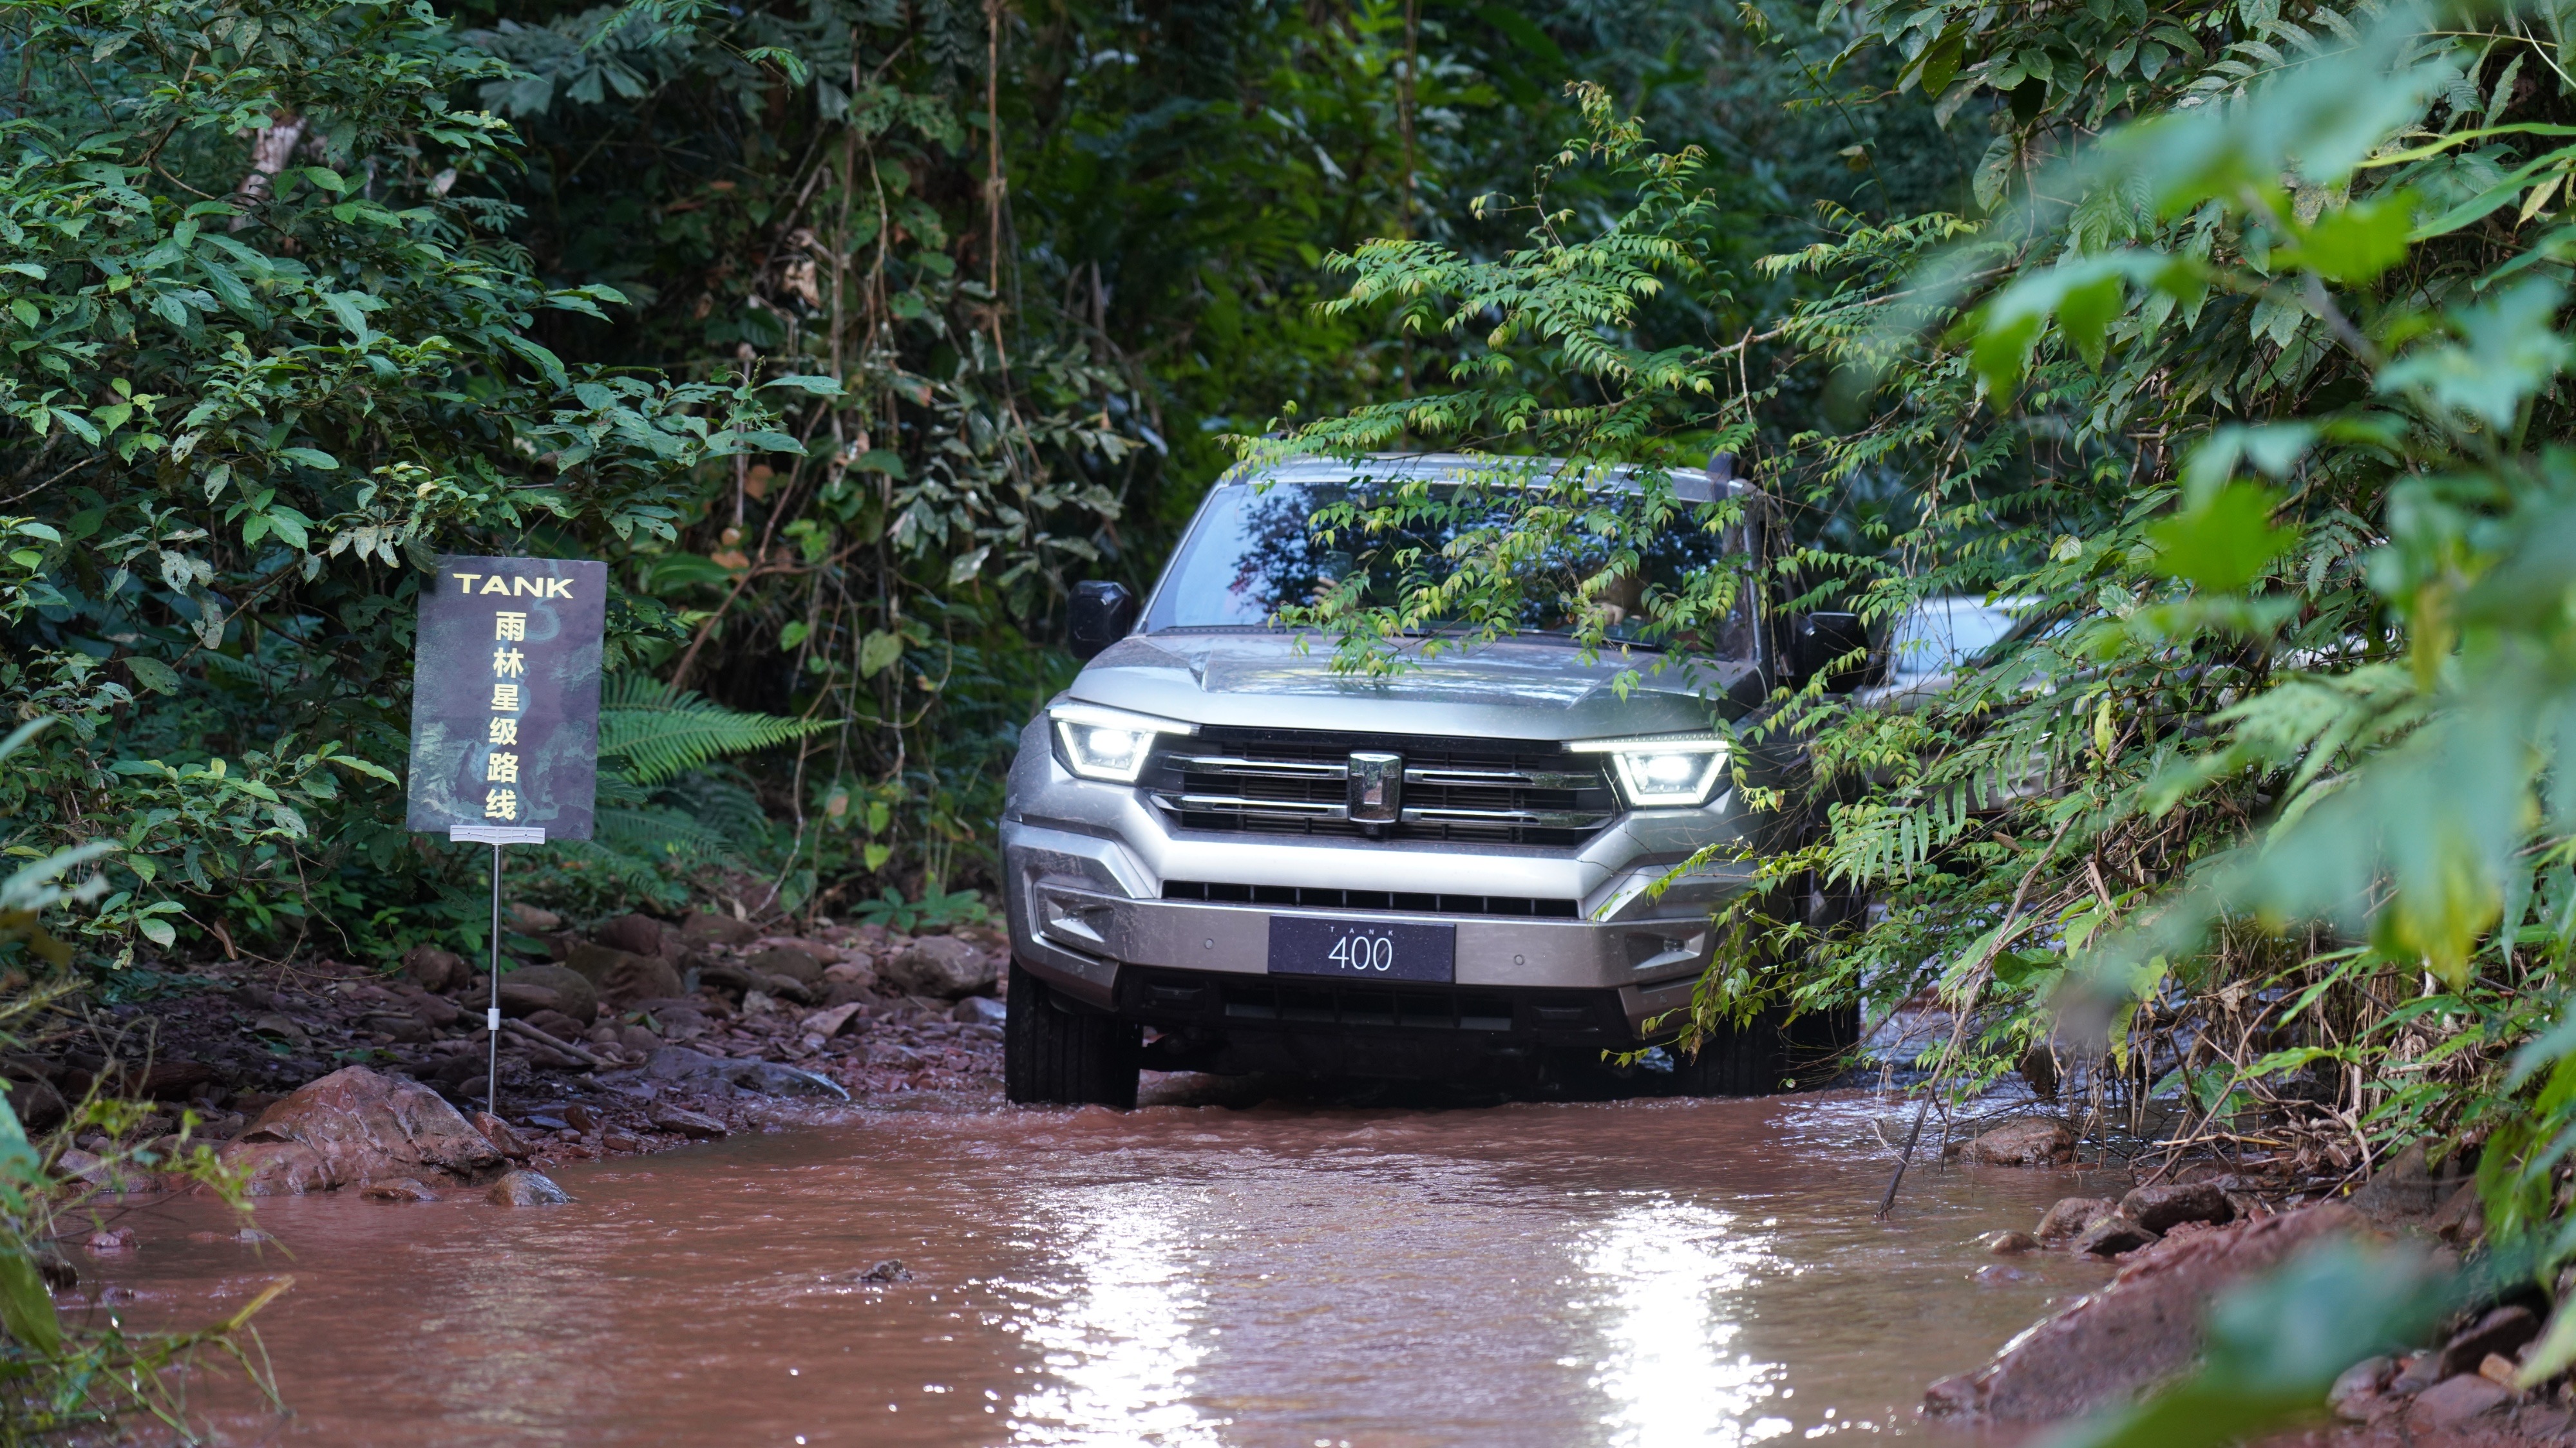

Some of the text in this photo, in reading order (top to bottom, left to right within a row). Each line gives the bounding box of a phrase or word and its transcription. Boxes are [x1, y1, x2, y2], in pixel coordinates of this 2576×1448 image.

[452, 573, 574, 599] TANK
[485, 611, 527, 820] 雨林星级路线
[1330, 926, 1394, 936] TANK
[1328, 936, 1392, 972] 400
